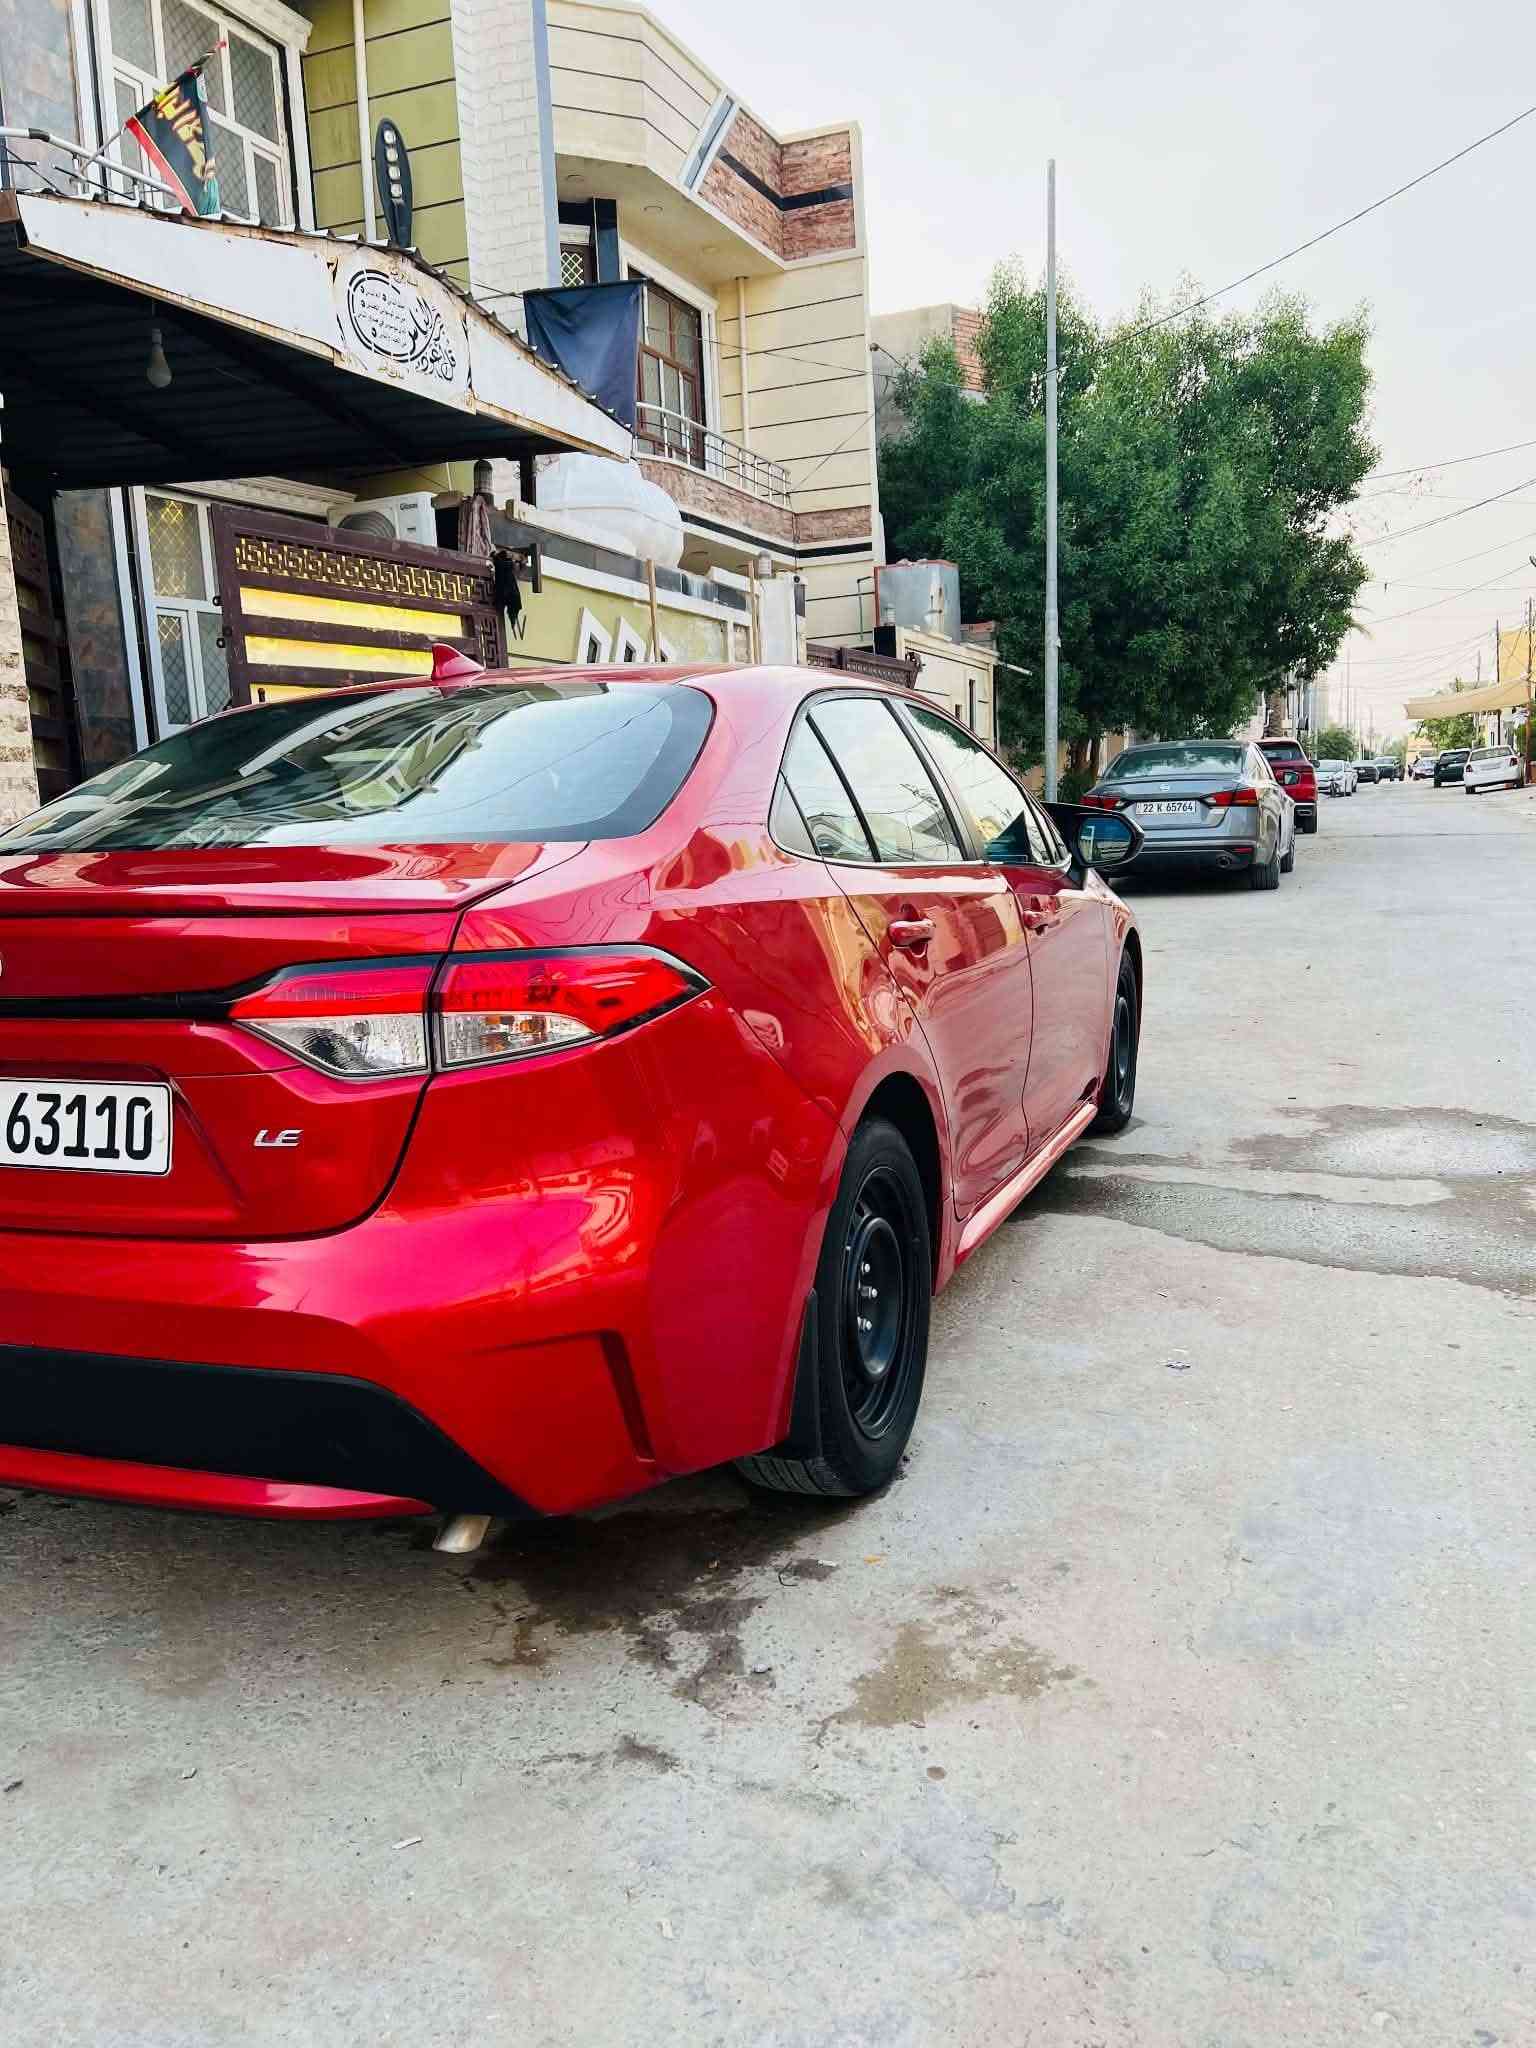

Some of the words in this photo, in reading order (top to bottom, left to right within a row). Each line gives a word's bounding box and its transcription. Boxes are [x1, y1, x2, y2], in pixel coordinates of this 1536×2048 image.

[1143, 803, 1154, 813] 22
[1166, 801, 1193, 812] 65764
[6, 1092, 153, 1160] 63110
[253, 1129, 304, 1147] LE
